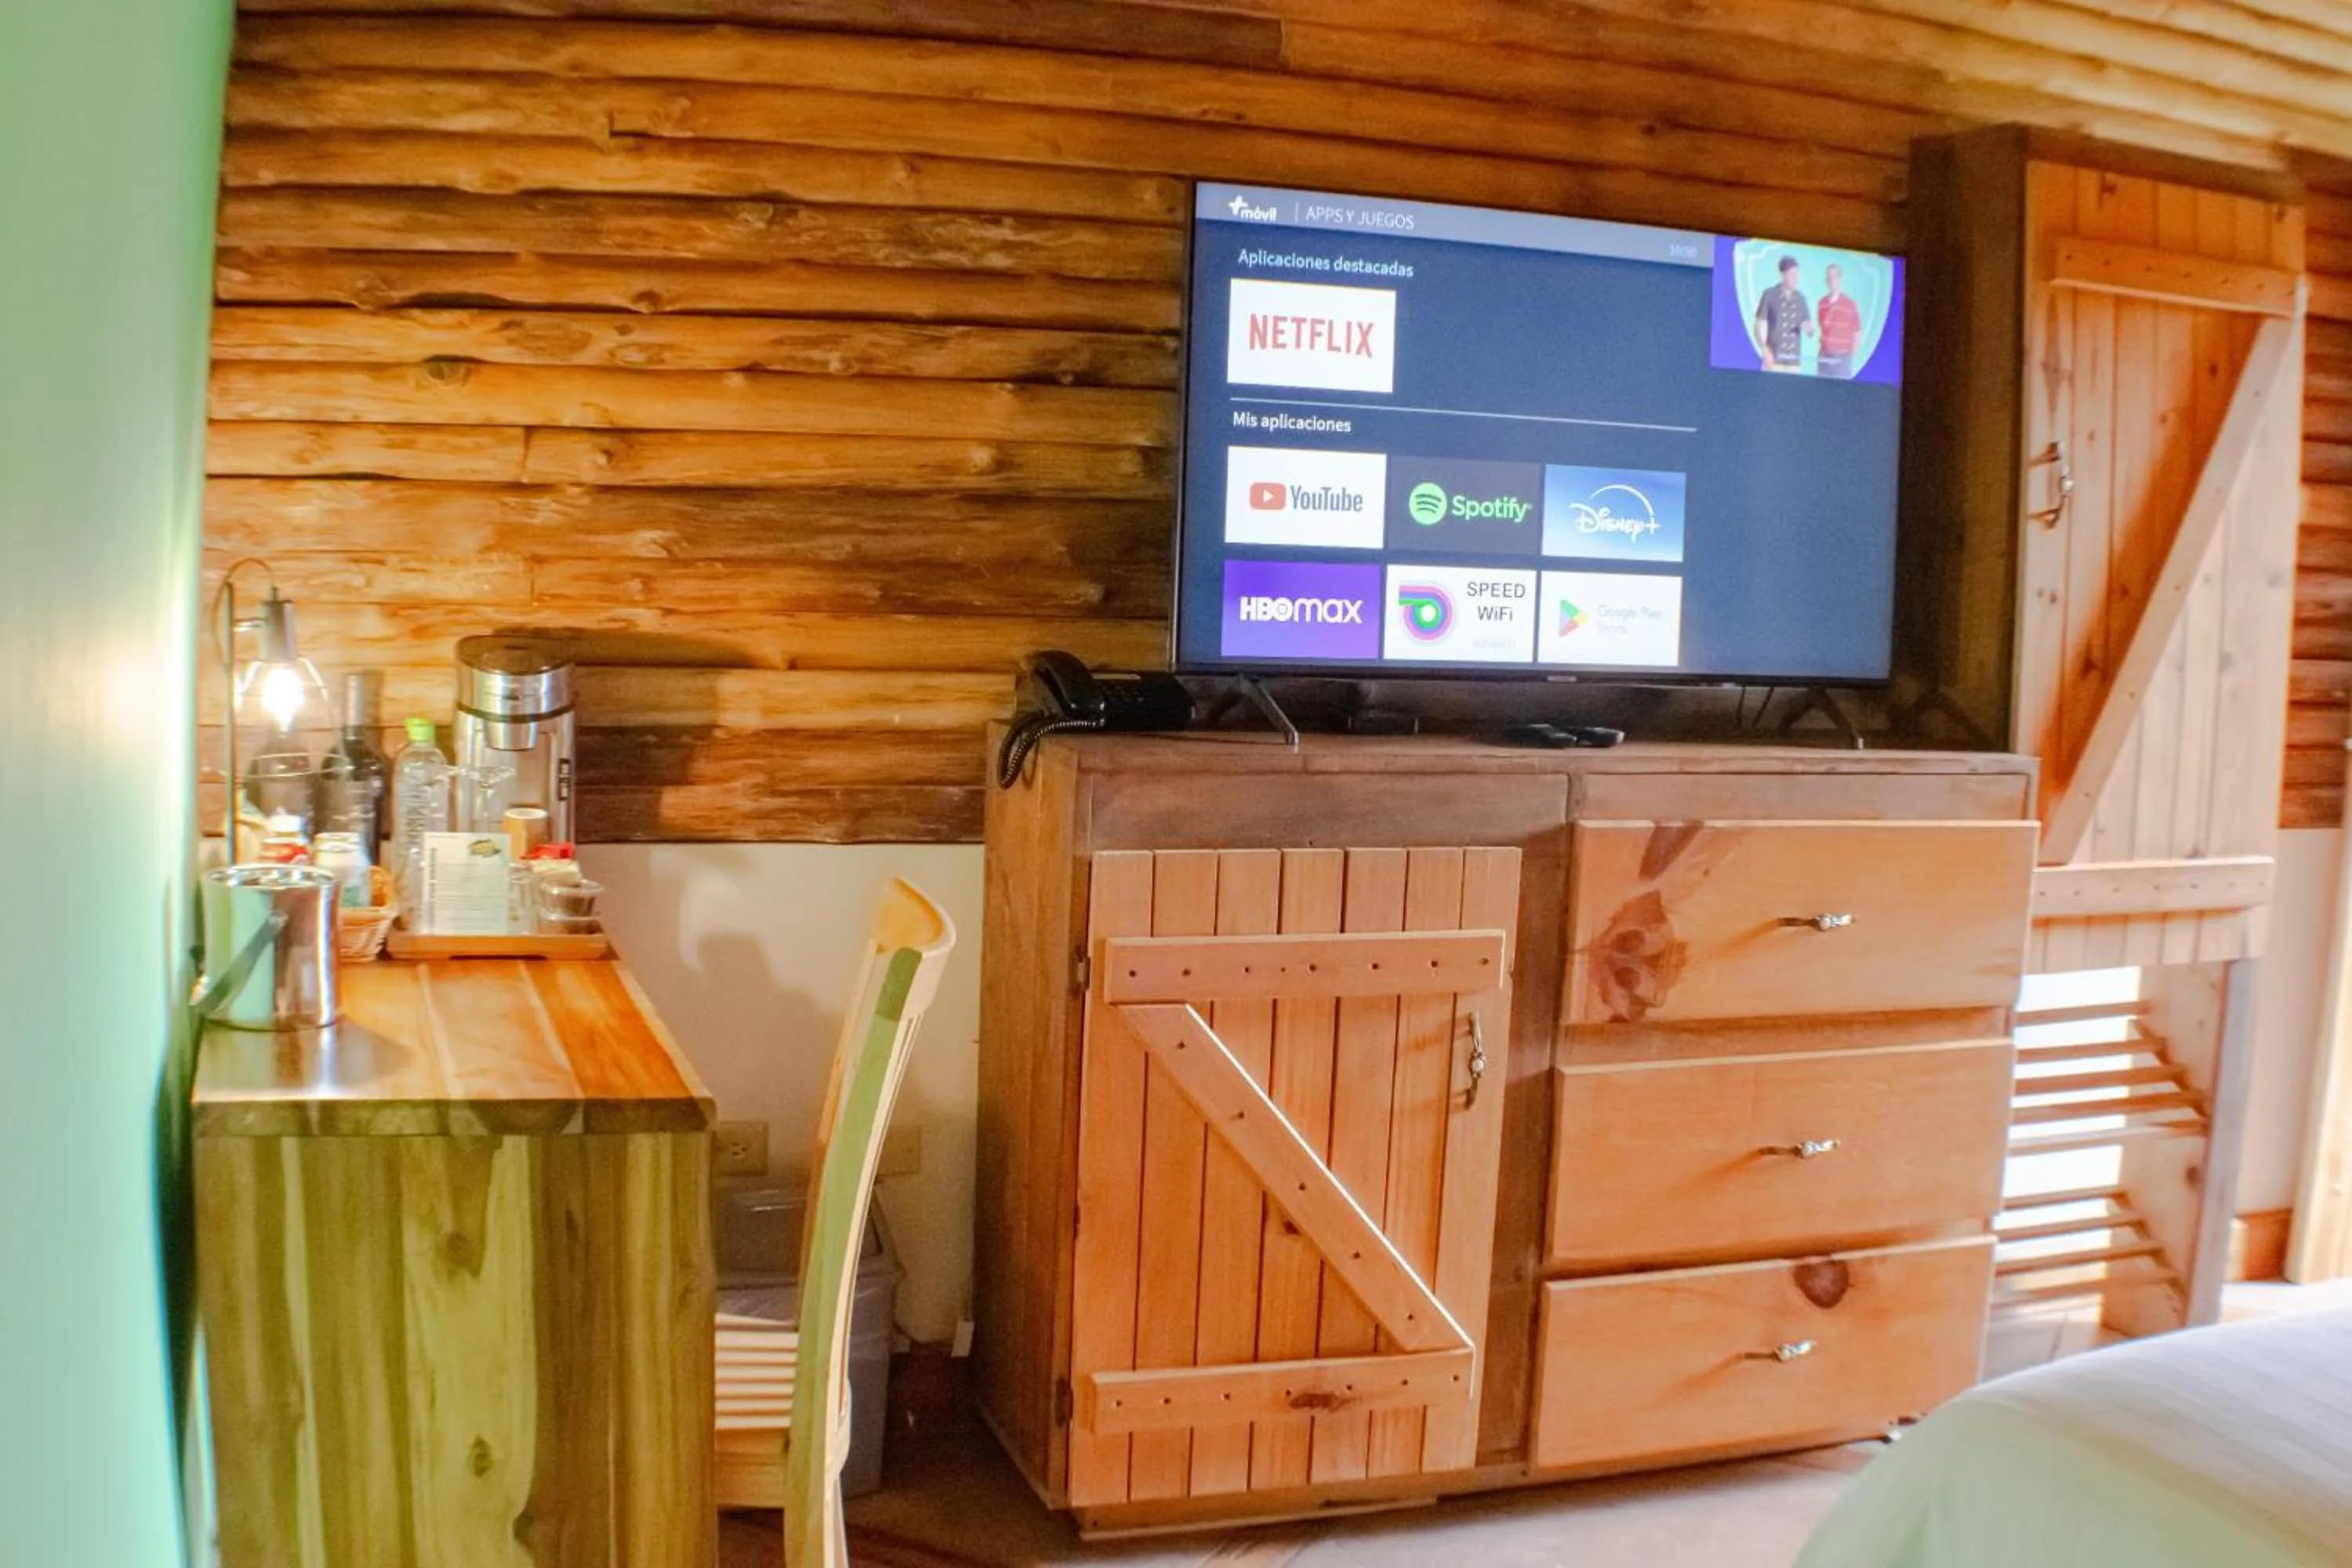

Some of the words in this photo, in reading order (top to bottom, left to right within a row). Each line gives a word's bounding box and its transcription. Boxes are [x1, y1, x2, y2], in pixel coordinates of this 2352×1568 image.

[1306, 205, 1344, 223] APPS
[1345, 208, 1355, 223] Y
[1358, 209, 1414, 230] JUEGOS
[1238, 248, 1330, 272] Aplicaciones
[1334, 256, 1414, 278] destacadas
[1248, 313, 1375, 359] NETFLIX
[1232, 411, 1258, 428] Mis
[1261, 412, 1352, 434] aplicaciones
[1290, 484, 1363, 513] YouTube
[1450, 493, 1529, 524] Spotify
[1466, 581, 1526, 599] SPEED
[1477, 605, 1514, 622] WiFi
